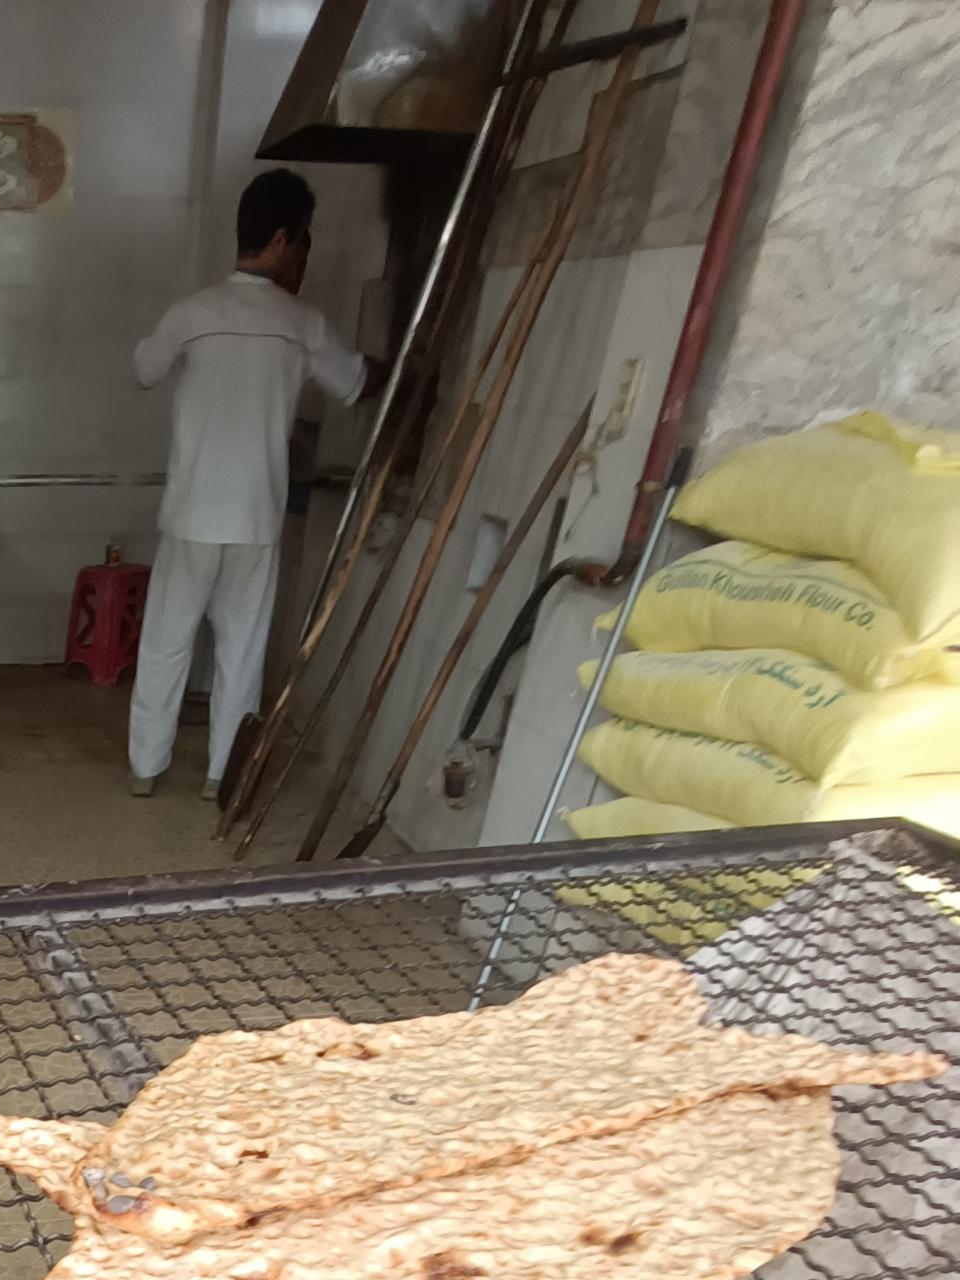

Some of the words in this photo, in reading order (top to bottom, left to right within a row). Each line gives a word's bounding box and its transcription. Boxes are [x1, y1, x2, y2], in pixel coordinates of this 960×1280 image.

[795, 584, 845, 615] Flour
[844, 602, 876, 632] Co.
[803, 682, 847, 709] آرد
